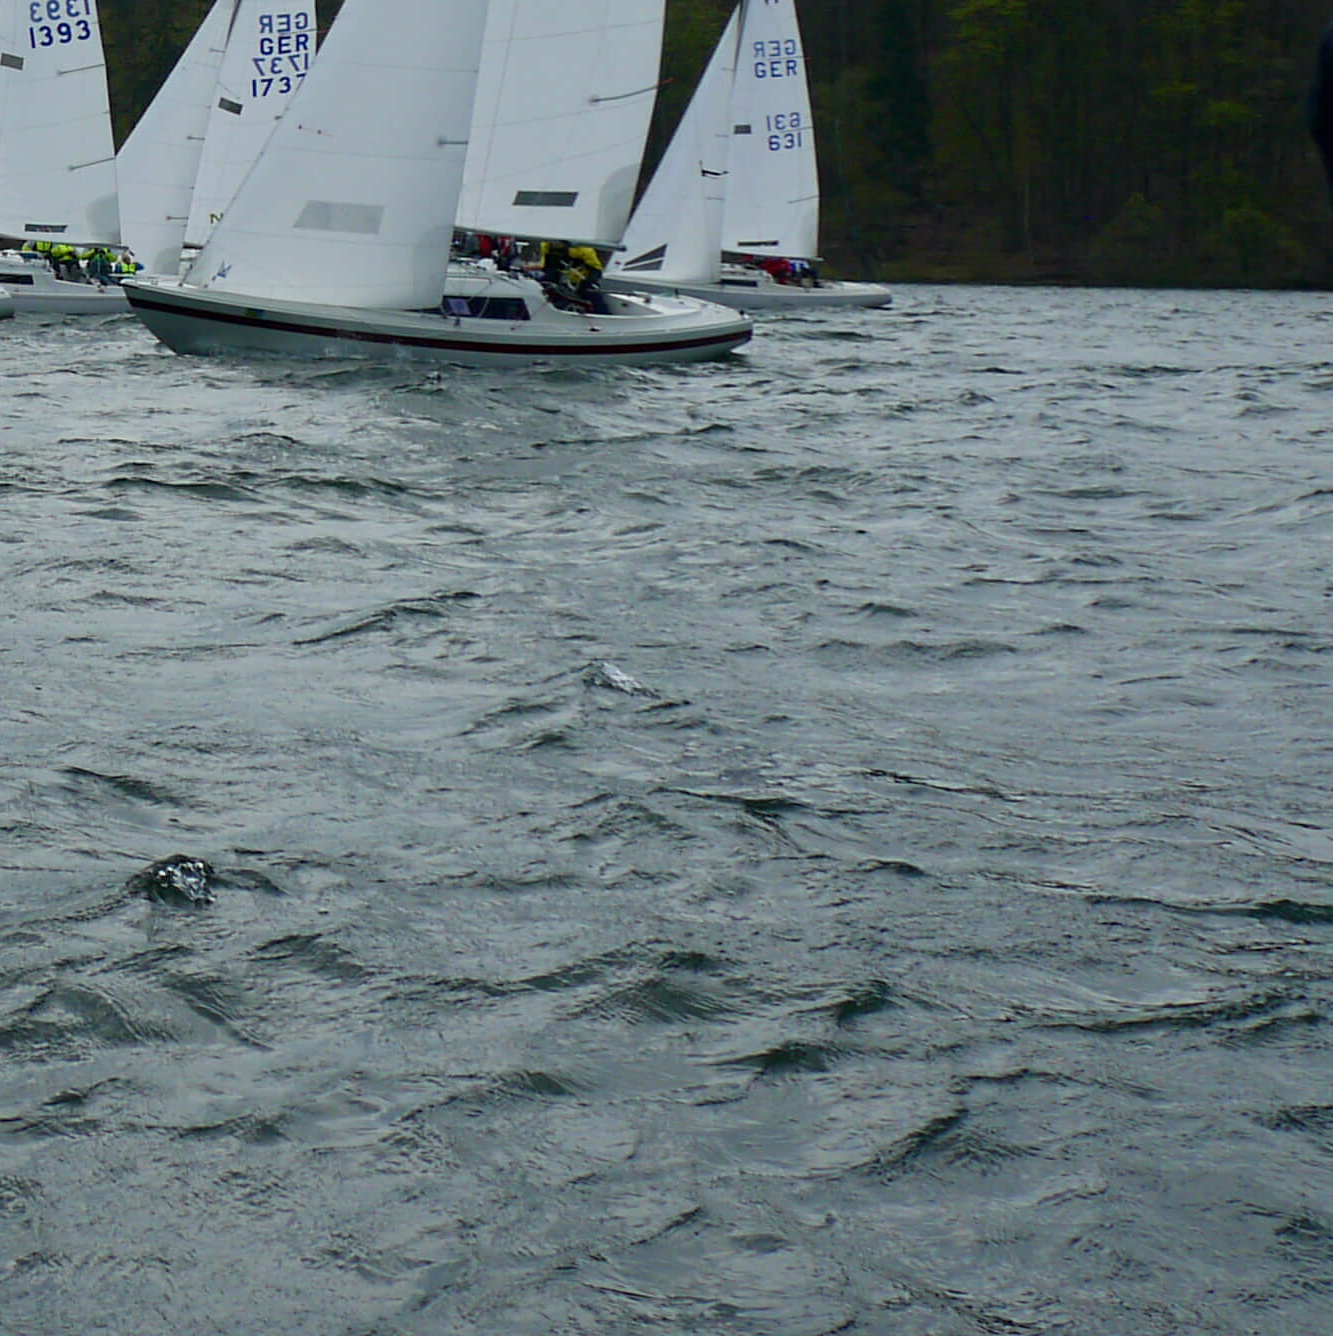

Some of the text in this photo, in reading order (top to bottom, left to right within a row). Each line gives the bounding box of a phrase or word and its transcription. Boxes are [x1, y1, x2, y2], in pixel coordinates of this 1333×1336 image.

[29, 20, 90, 48] 1393
[260, 34, 308, 55] GER
[754, 60, 797, 78] GER
[769, 132, 801, 151] 631
